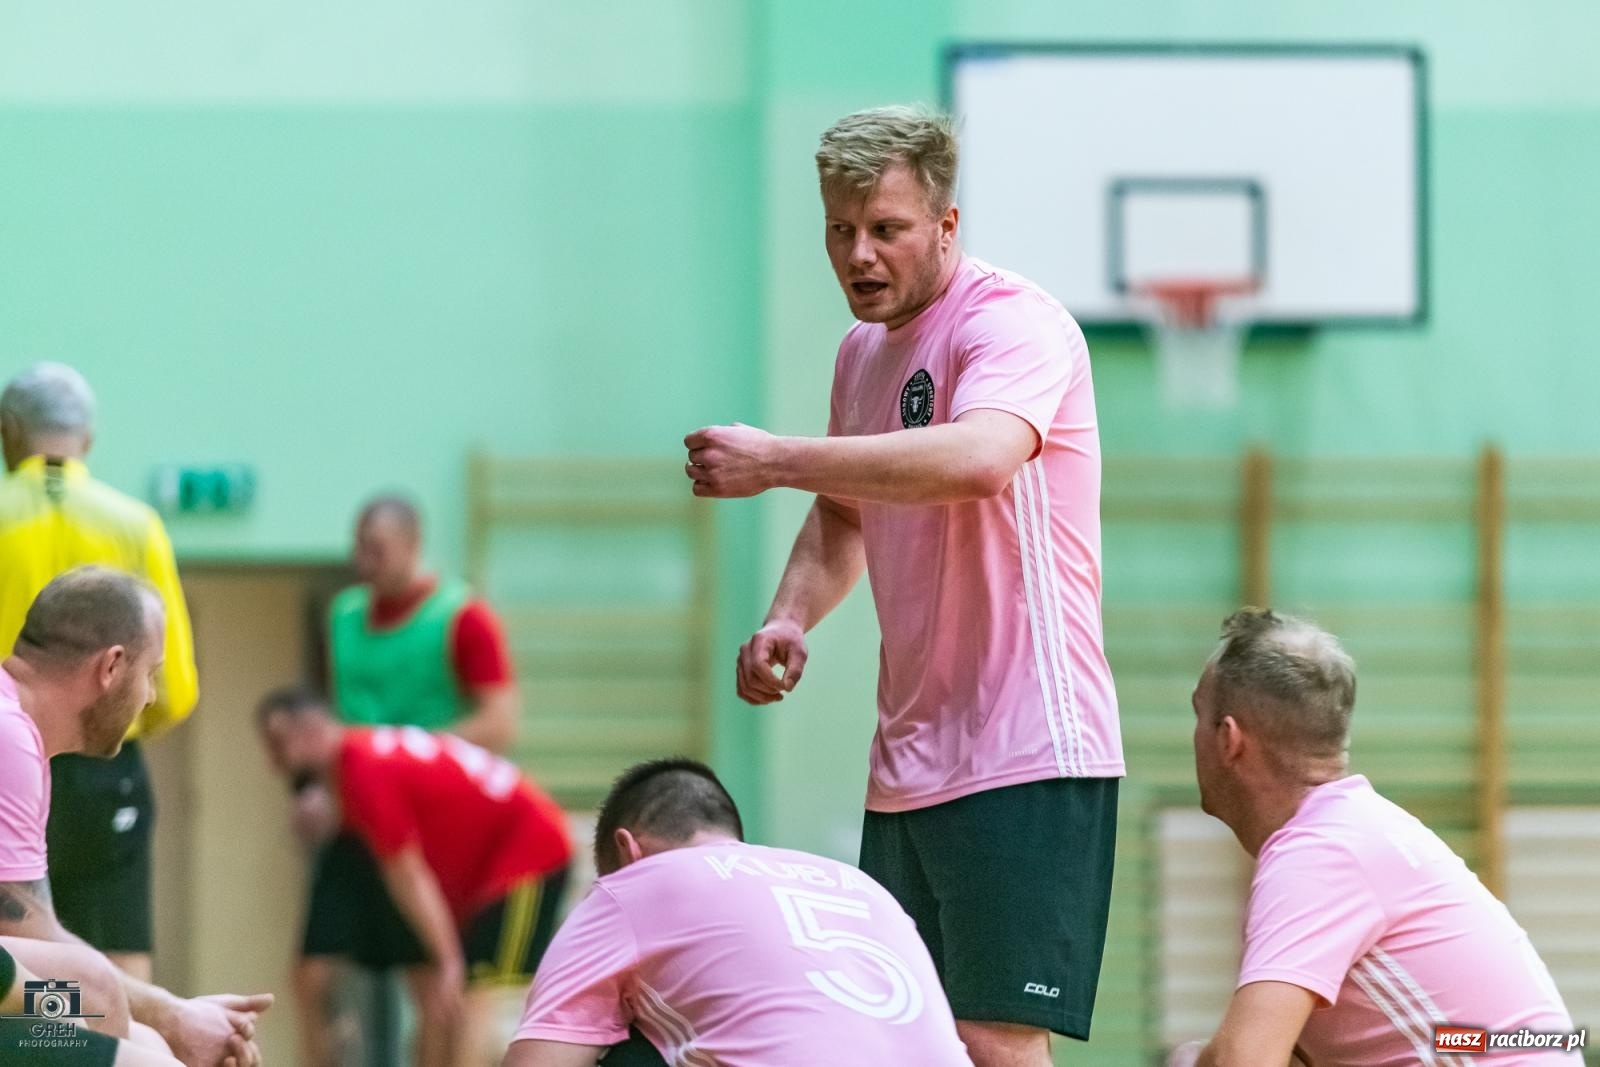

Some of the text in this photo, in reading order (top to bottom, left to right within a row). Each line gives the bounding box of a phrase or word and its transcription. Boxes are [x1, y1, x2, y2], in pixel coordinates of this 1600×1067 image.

[704, 854, 878, 896] KUBA
[770, 885, 924, 1025] 5
[1023, 982, 1060, 998] COLO
